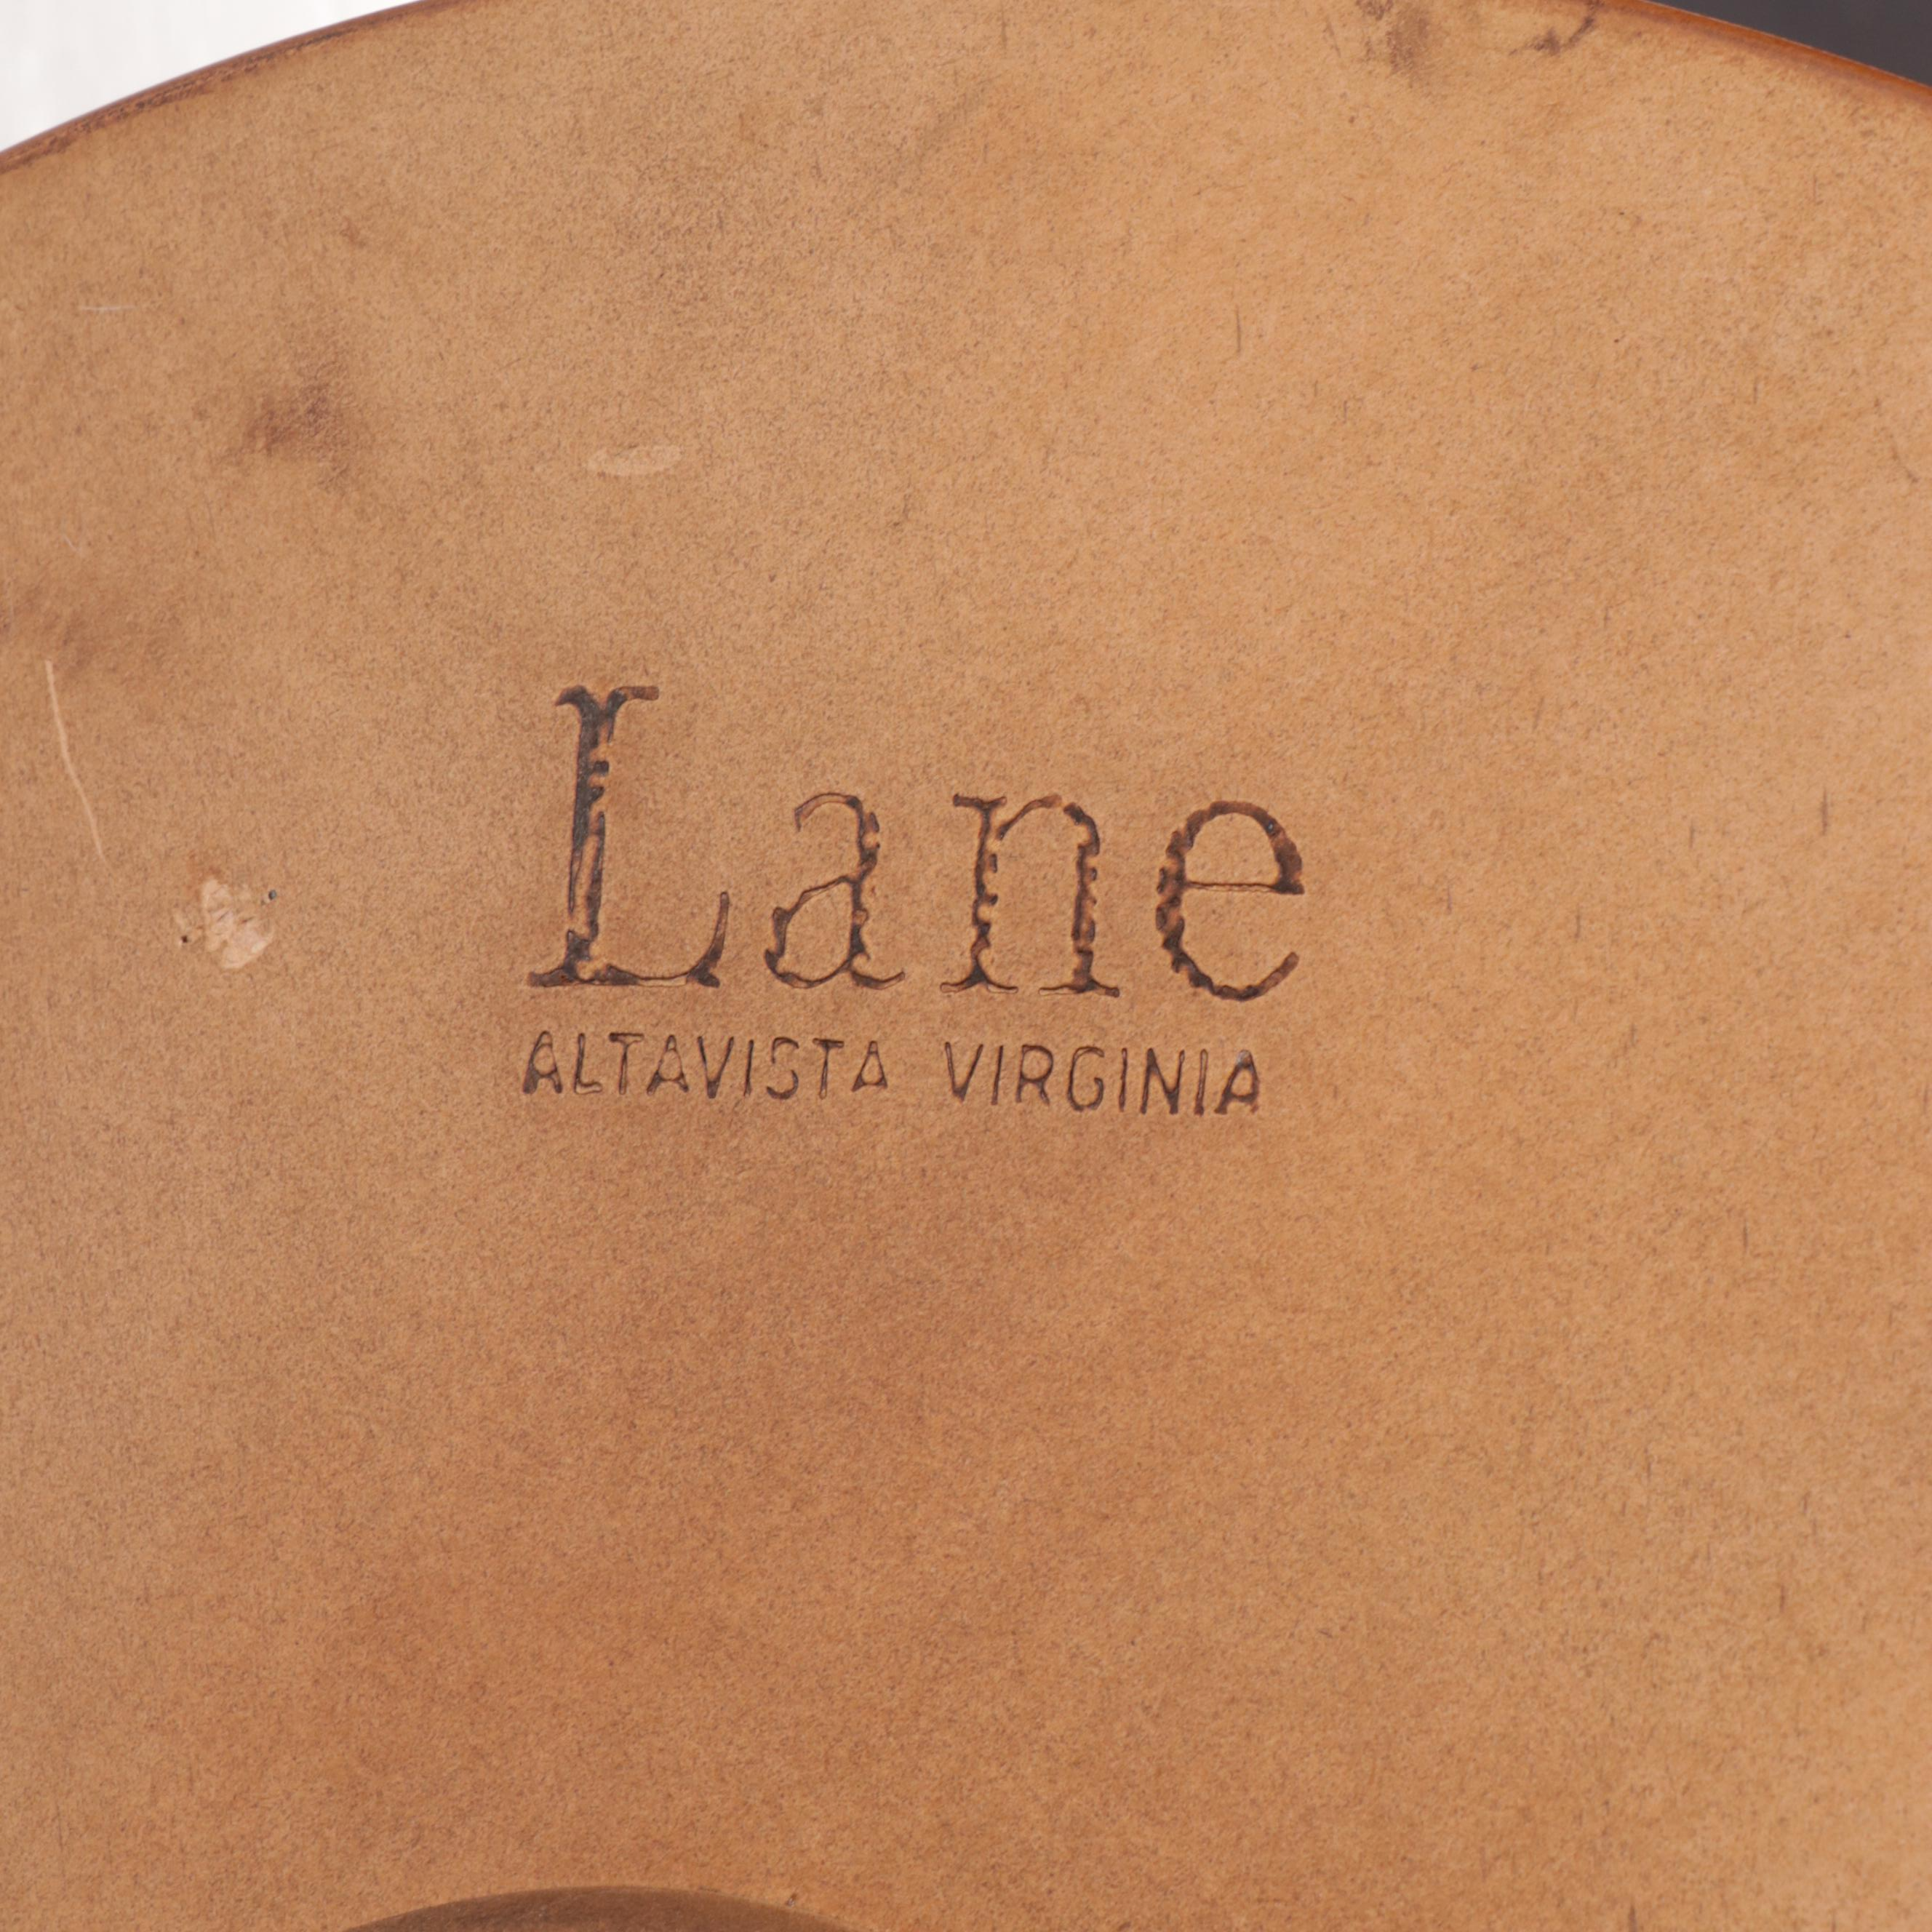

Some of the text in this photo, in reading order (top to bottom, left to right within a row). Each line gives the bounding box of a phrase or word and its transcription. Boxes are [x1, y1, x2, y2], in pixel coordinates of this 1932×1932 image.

[527, 685, 1305, 1002] Lane
[522, 1031, 1261, 1116] ALTAVISTA VIRGINIA
